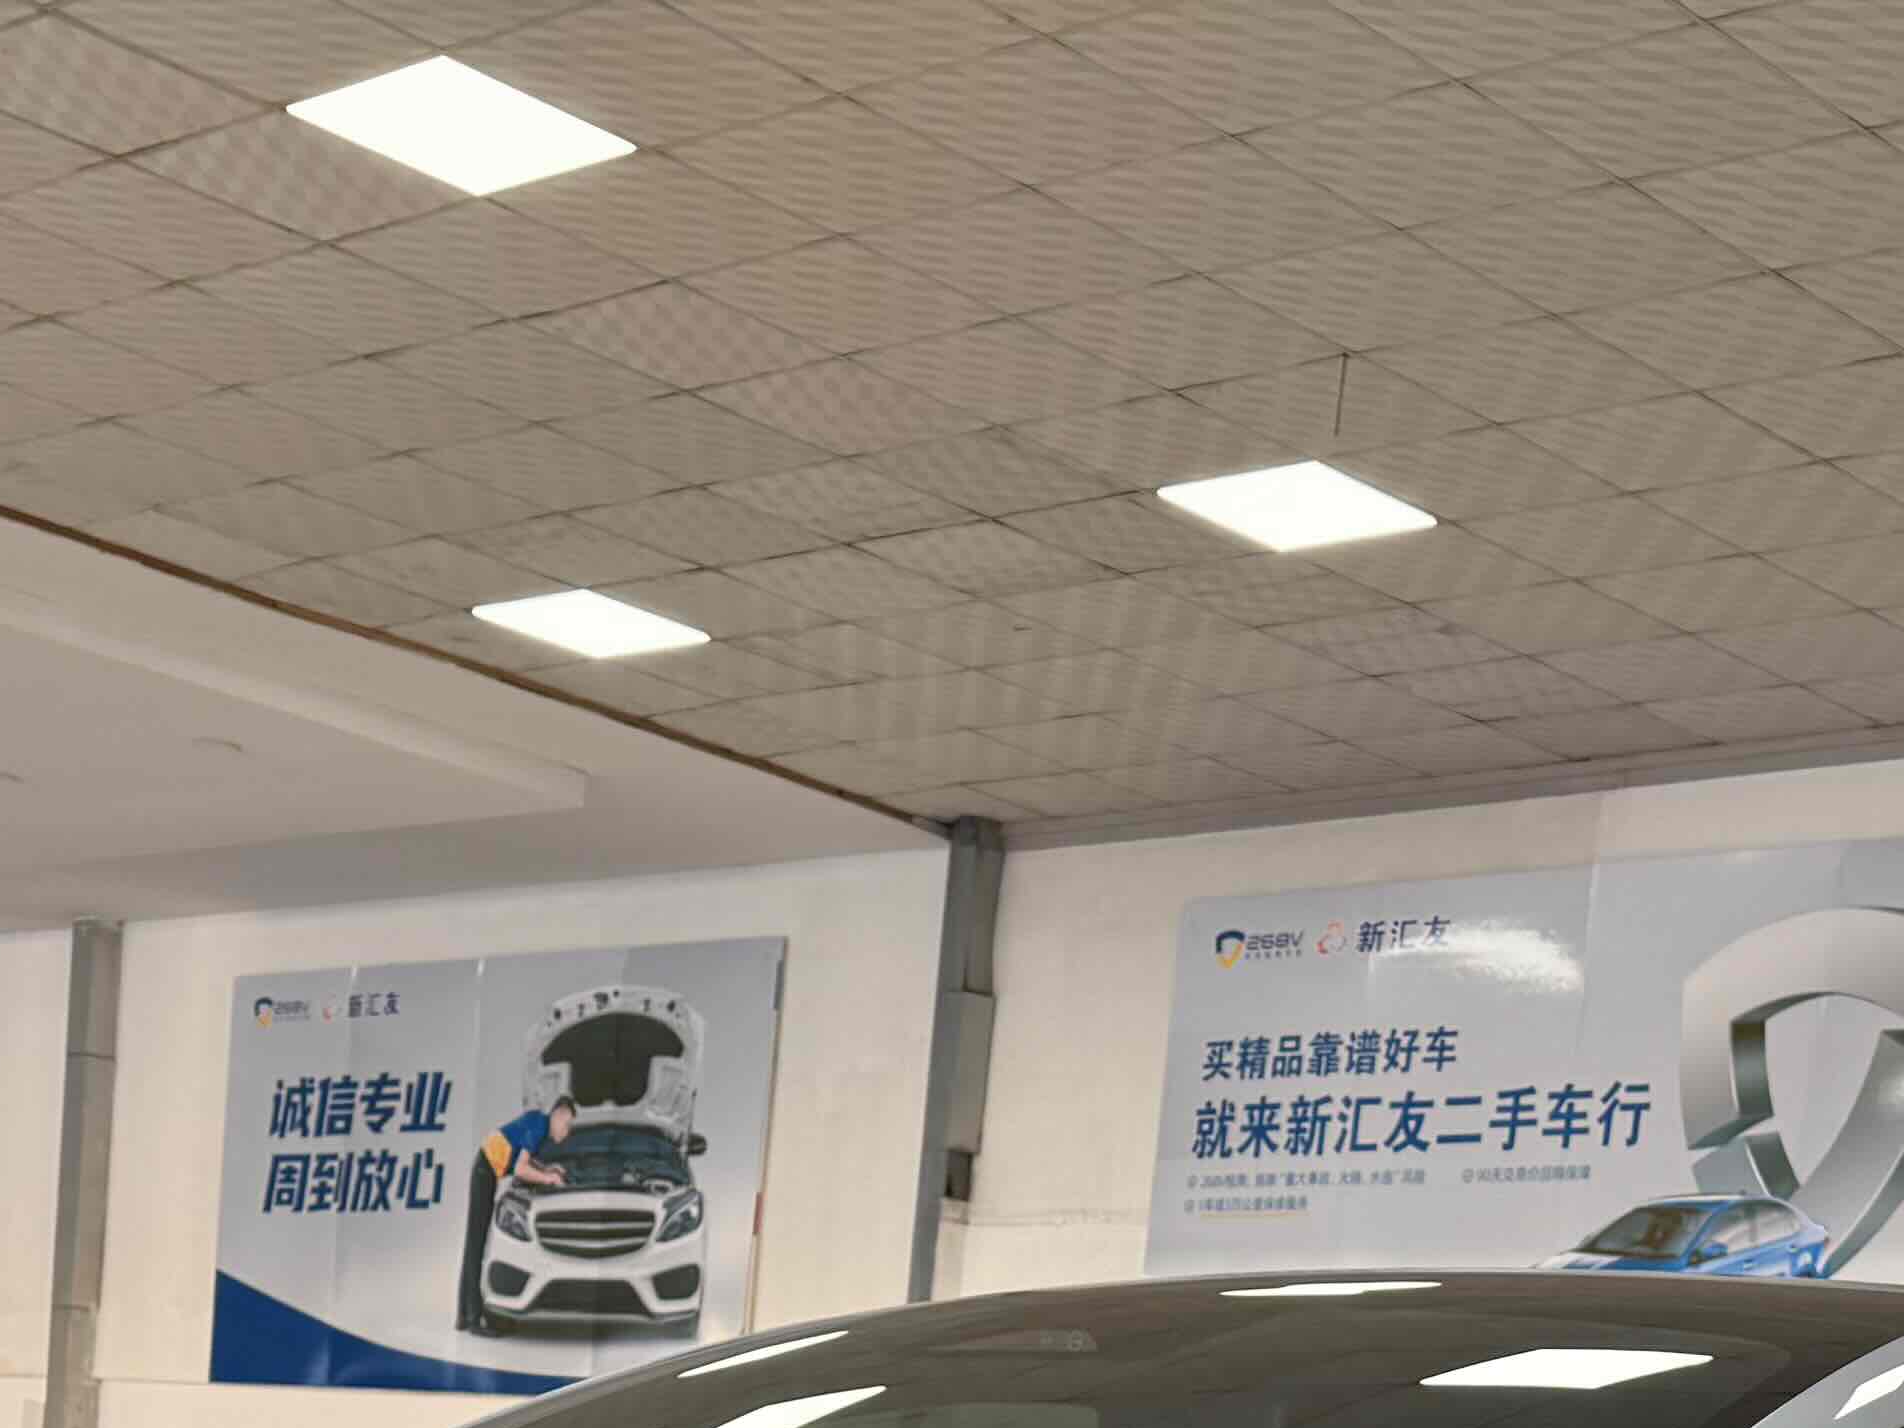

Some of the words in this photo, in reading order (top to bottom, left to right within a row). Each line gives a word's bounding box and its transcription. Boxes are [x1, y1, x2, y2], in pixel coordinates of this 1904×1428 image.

[1200, 1024, 1459, 1082] 买精品靠谱好车
[268, 1070, 453, 1139] 诚信专业
[1189, 1079, 1653, 1160] 就来新汇友二手车行
[261, 1147, 446, 1215] 周到放心
